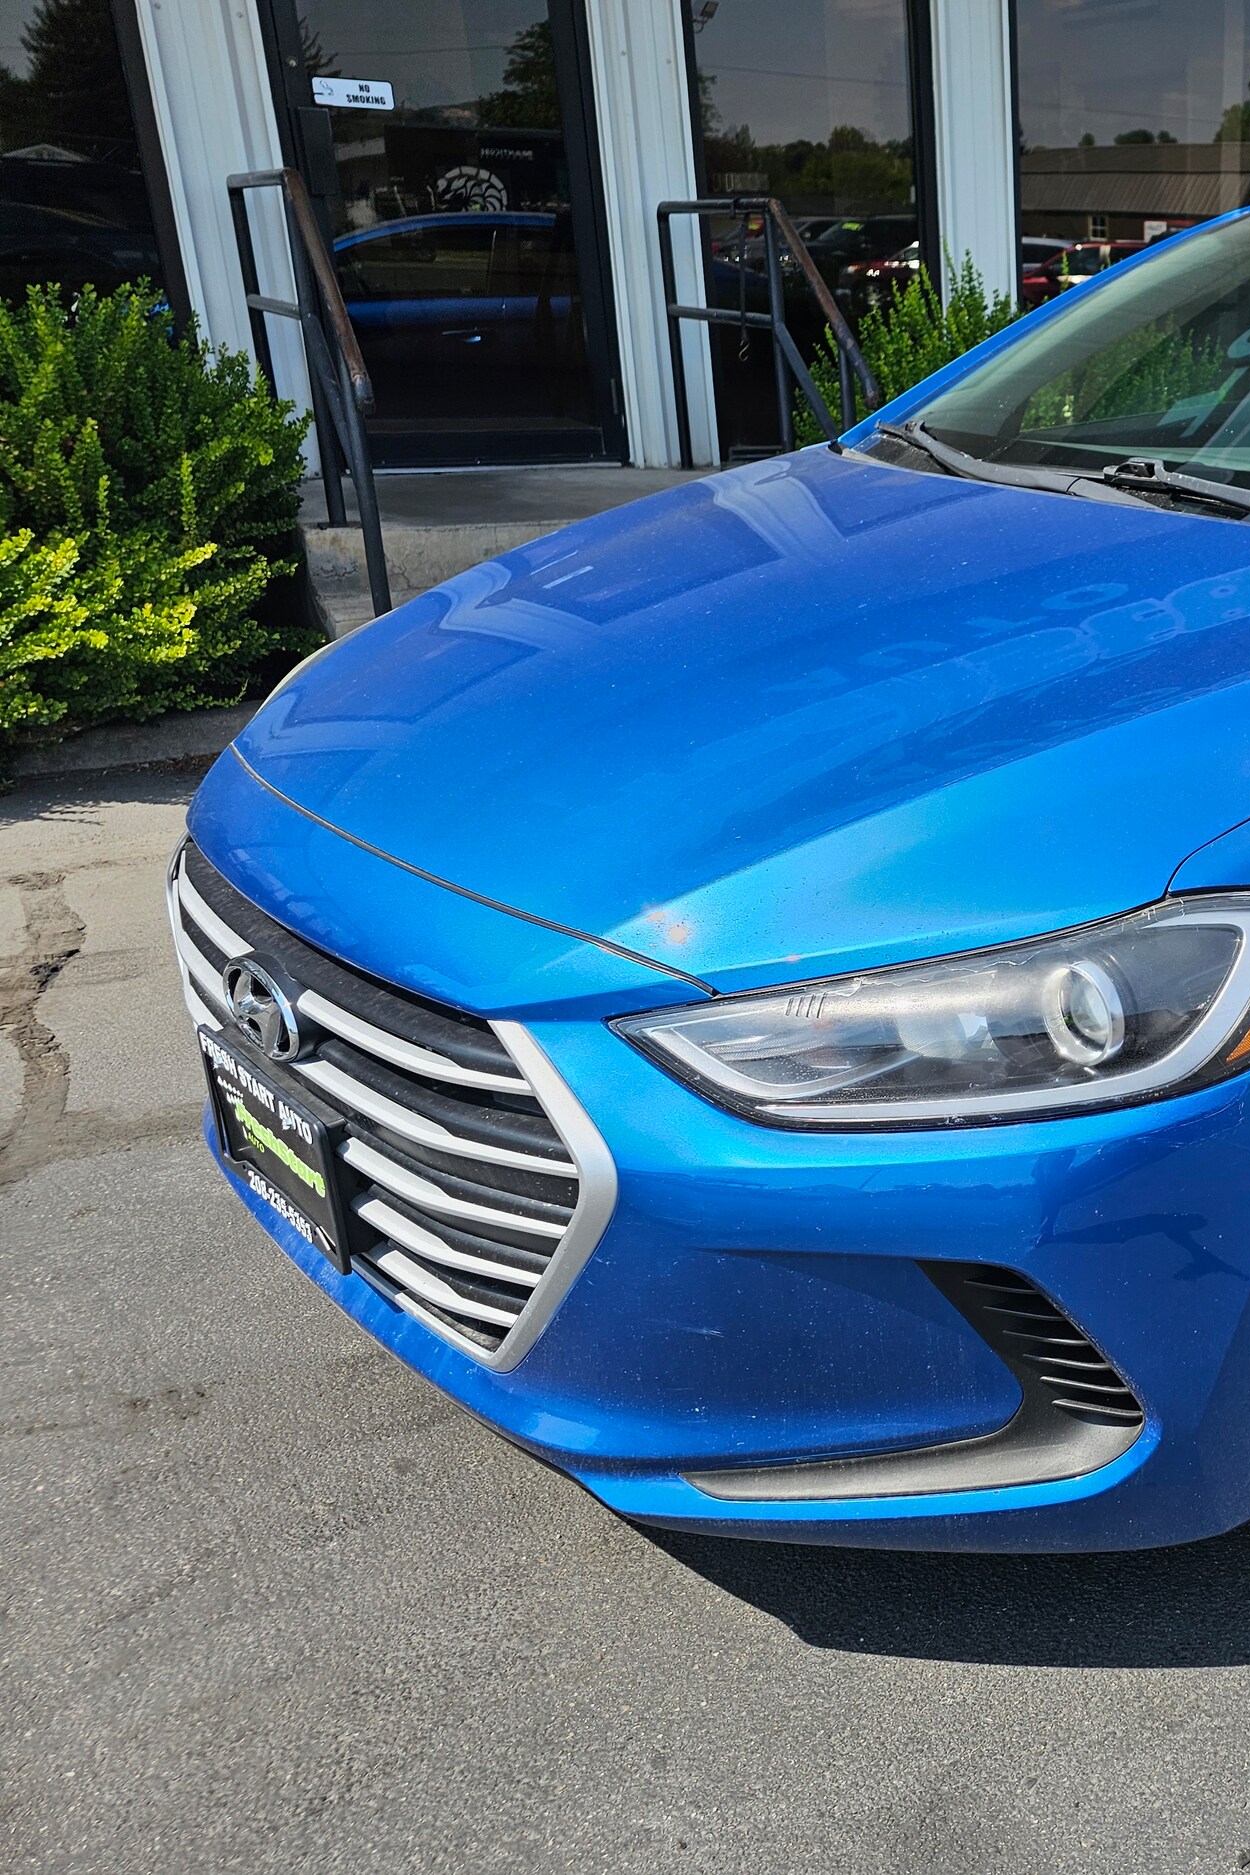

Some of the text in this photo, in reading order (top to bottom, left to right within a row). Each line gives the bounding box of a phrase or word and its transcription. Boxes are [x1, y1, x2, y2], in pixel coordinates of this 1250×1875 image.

[346, 93, 386, 105] SMOKING
[358, 83, 370, 93] NO
[199, 1031, 313, 1145] FRESH START AUTO
[247, 1169, 313, 1244] 208-235-5353
